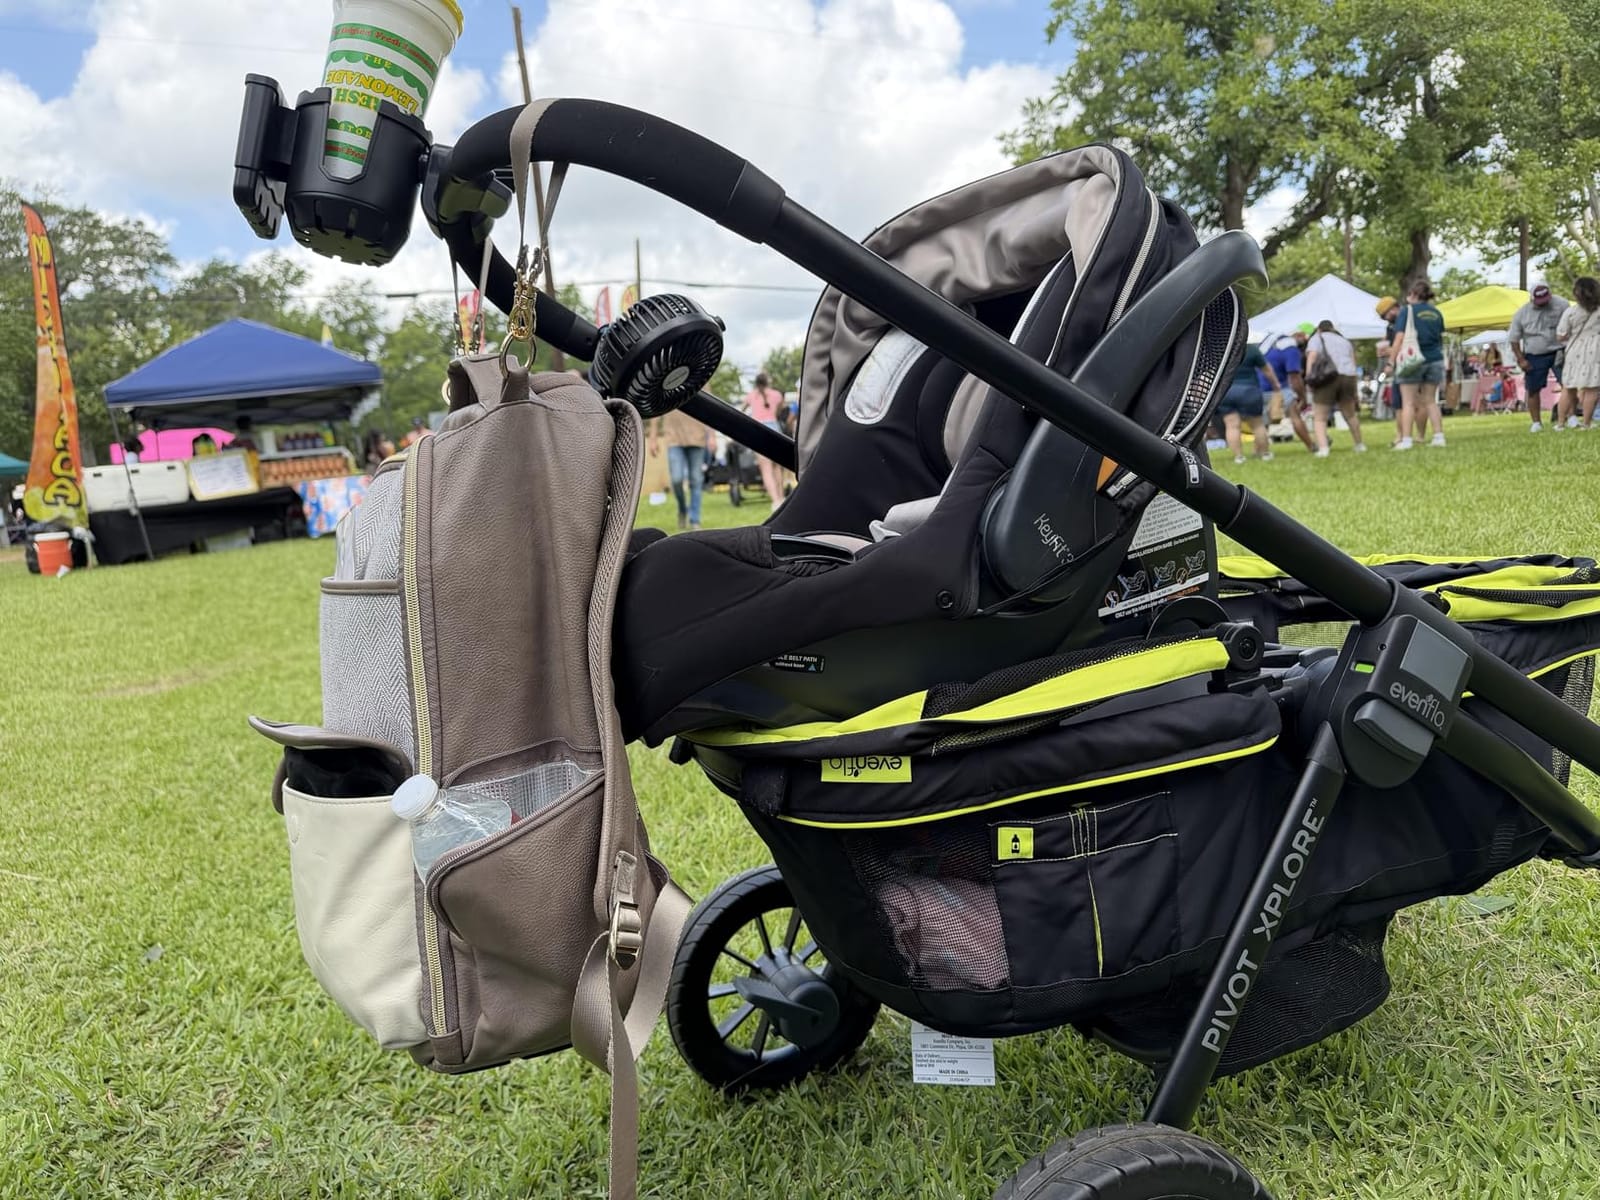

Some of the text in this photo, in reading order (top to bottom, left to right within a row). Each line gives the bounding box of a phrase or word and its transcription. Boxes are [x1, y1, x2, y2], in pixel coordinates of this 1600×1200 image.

[364, 54, 393, 69] THE
[326, 69, 419, 115] LEMONADE
[1389, 681, 1446, 728] evenflo
[829, 756, 902, 777] evenflo
[1201, 949, 1258, 1054] PIVOT
